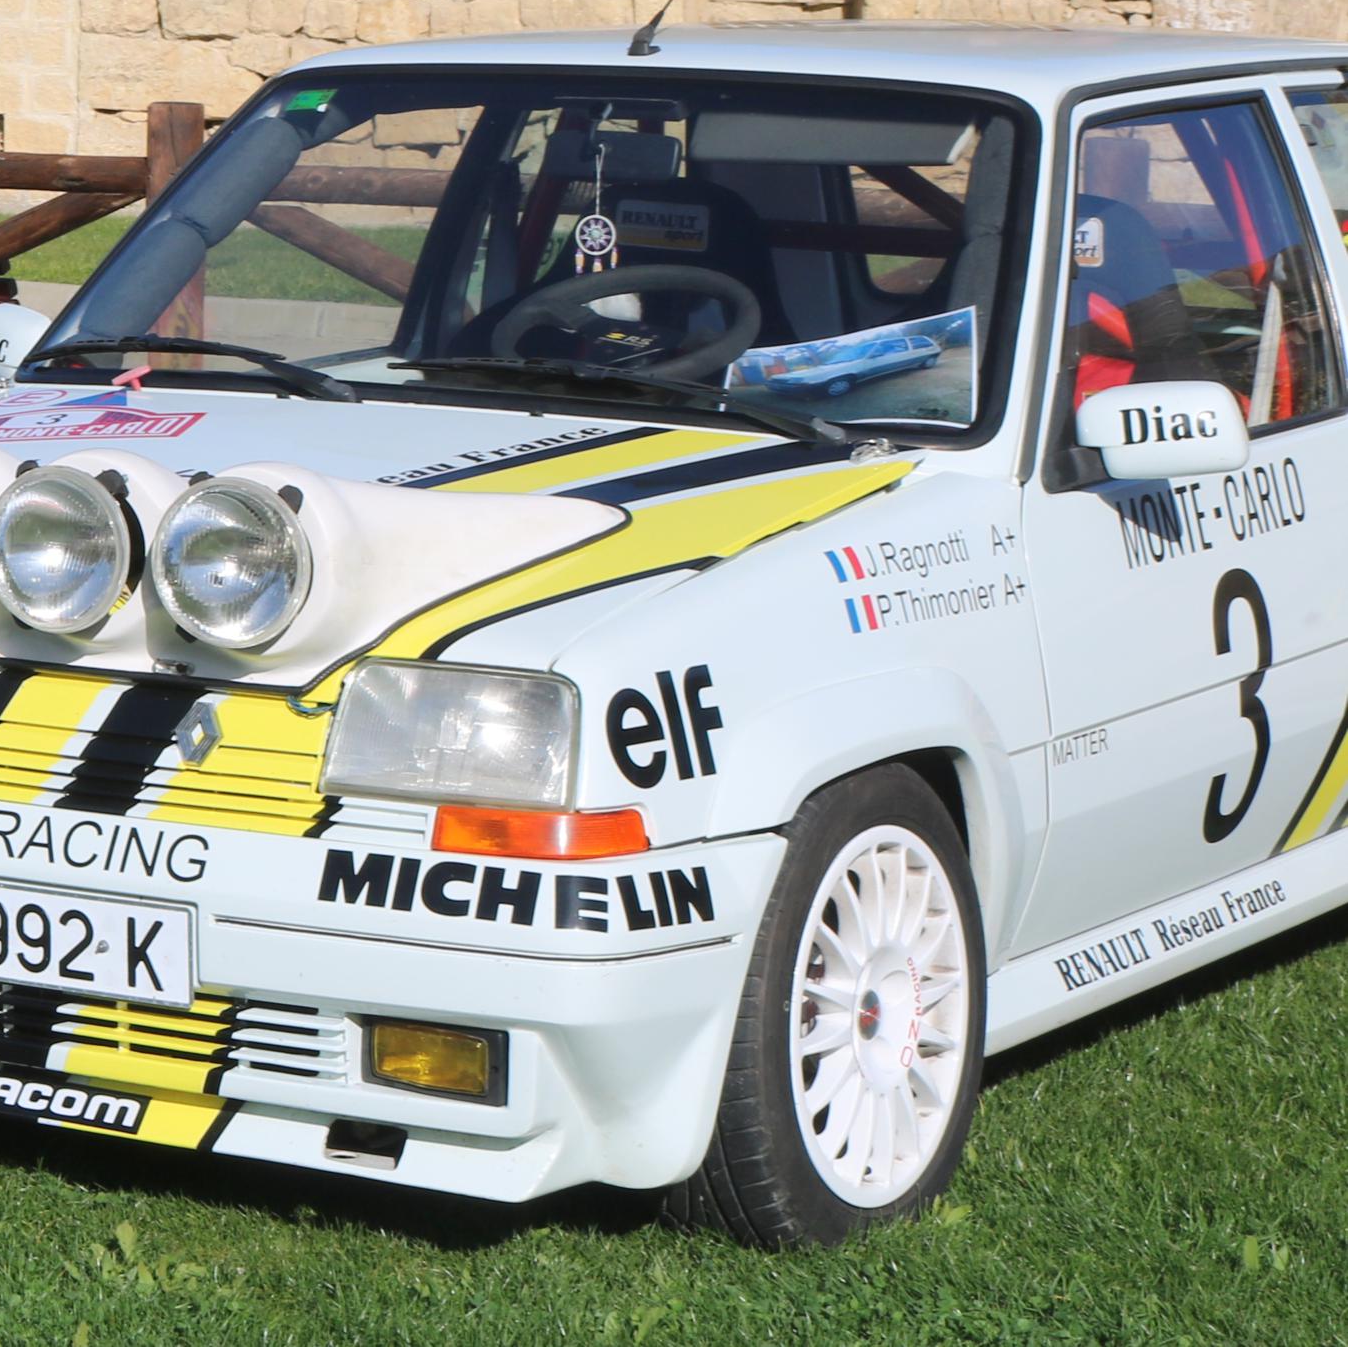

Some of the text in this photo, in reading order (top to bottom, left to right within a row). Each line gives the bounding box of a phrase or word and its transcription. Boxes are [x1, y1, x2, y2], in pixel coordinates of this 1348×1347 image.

[622, 210, 697, 230] RENAULT
[36, 414, 68, 425] 3
[1119, 405, 1218, 446] Diac
[365, 424, 609, 484] eau France
[865, 523, 1015, 578] J.Ragnotti A+
[876, 573, 1026, 628] P.Thimonier A+
[605, 664, 723, 789] elf
[1202, 568, 1273, 844] 3
[1052, 728, 1109, 767] MATTER
[317, 848, 715, 933] MICHELIN
[126, 915, 164, 992] K
[1053, 878, 1287, 992] RENAULT Réseau France
